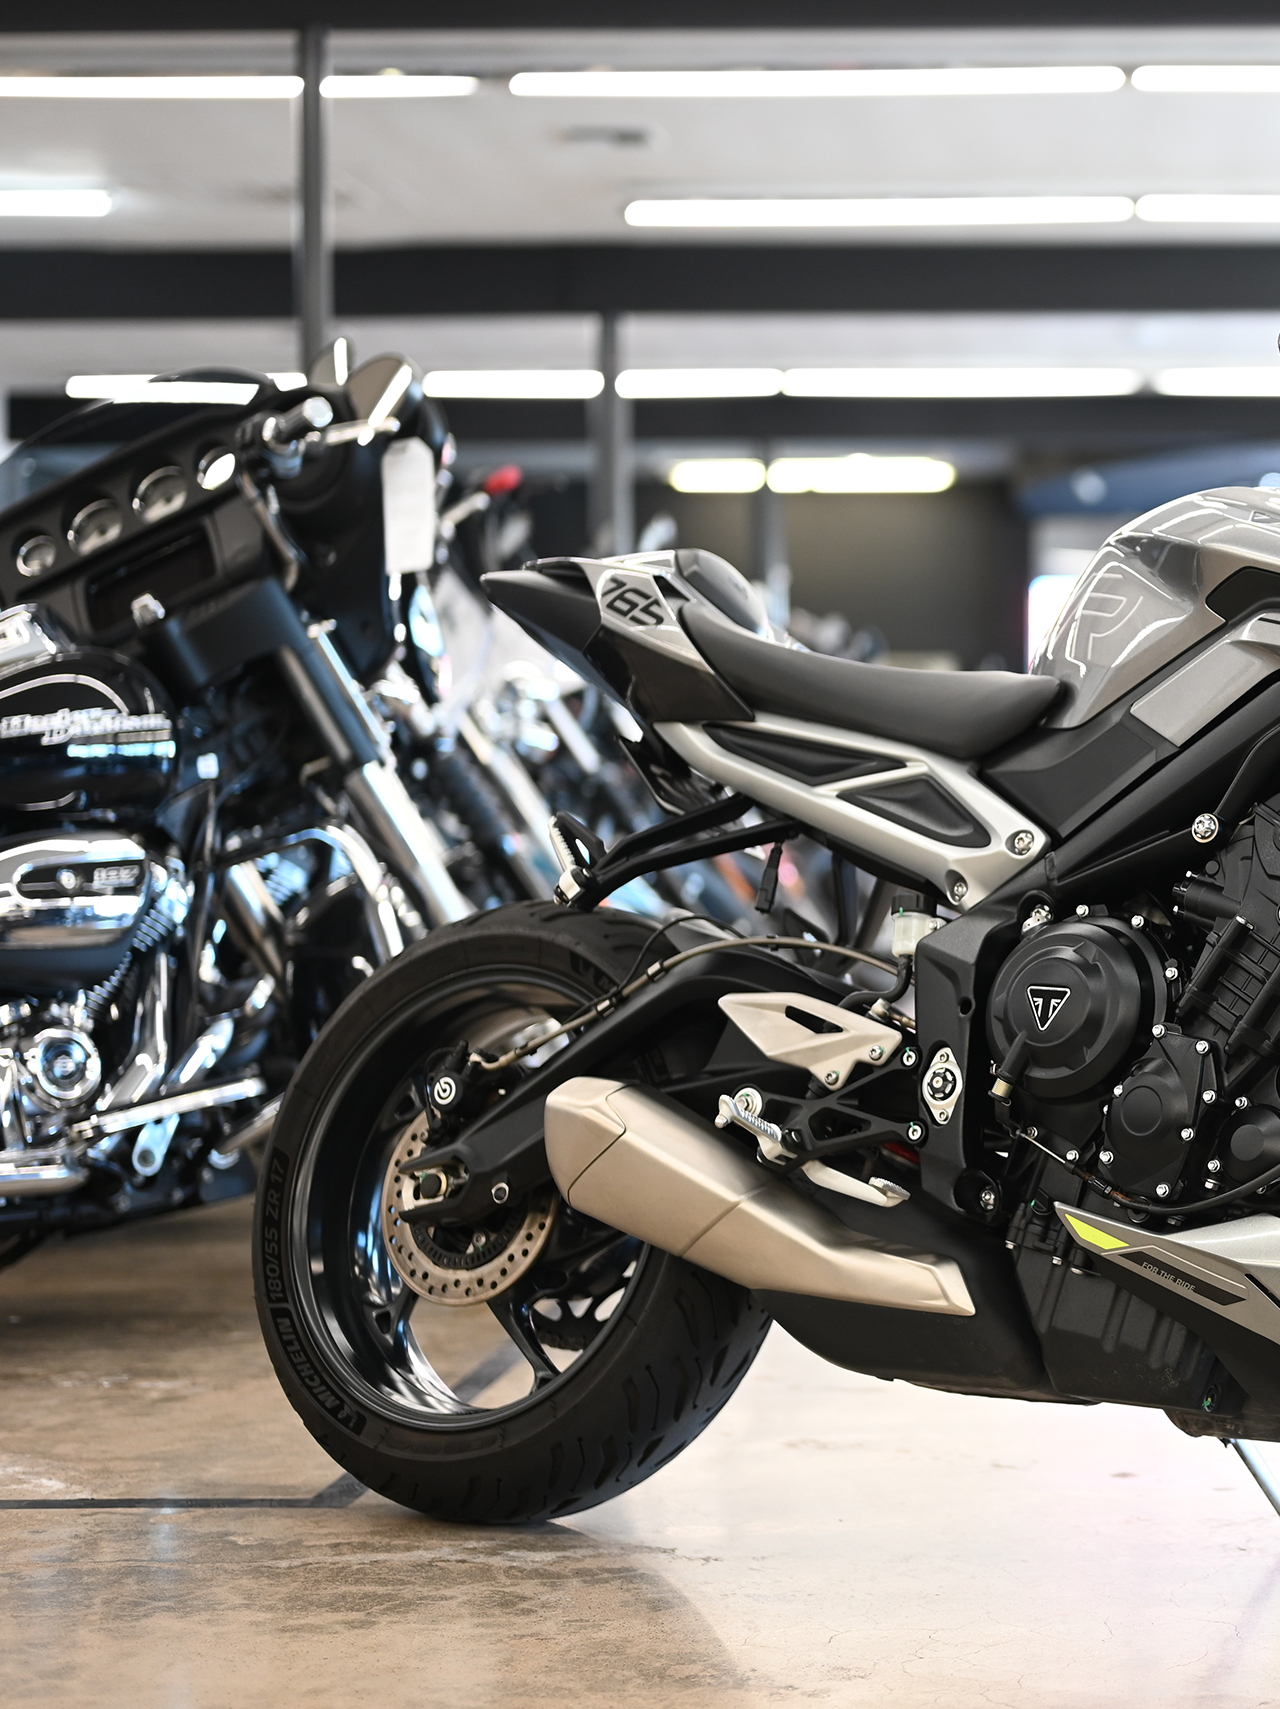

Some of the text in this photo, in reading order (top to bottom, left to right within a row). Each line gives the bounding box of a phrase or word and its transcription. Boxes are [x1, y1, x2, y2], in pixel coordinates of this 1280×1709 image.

[600, 577, 664, 626] 765
[265, 1162, 285, 1302] 180/55 ZR 17
[1141, 1261, 1197, 1292] FOR THE RIDE
[276, 1317, 343, 1412] MICHELIN
